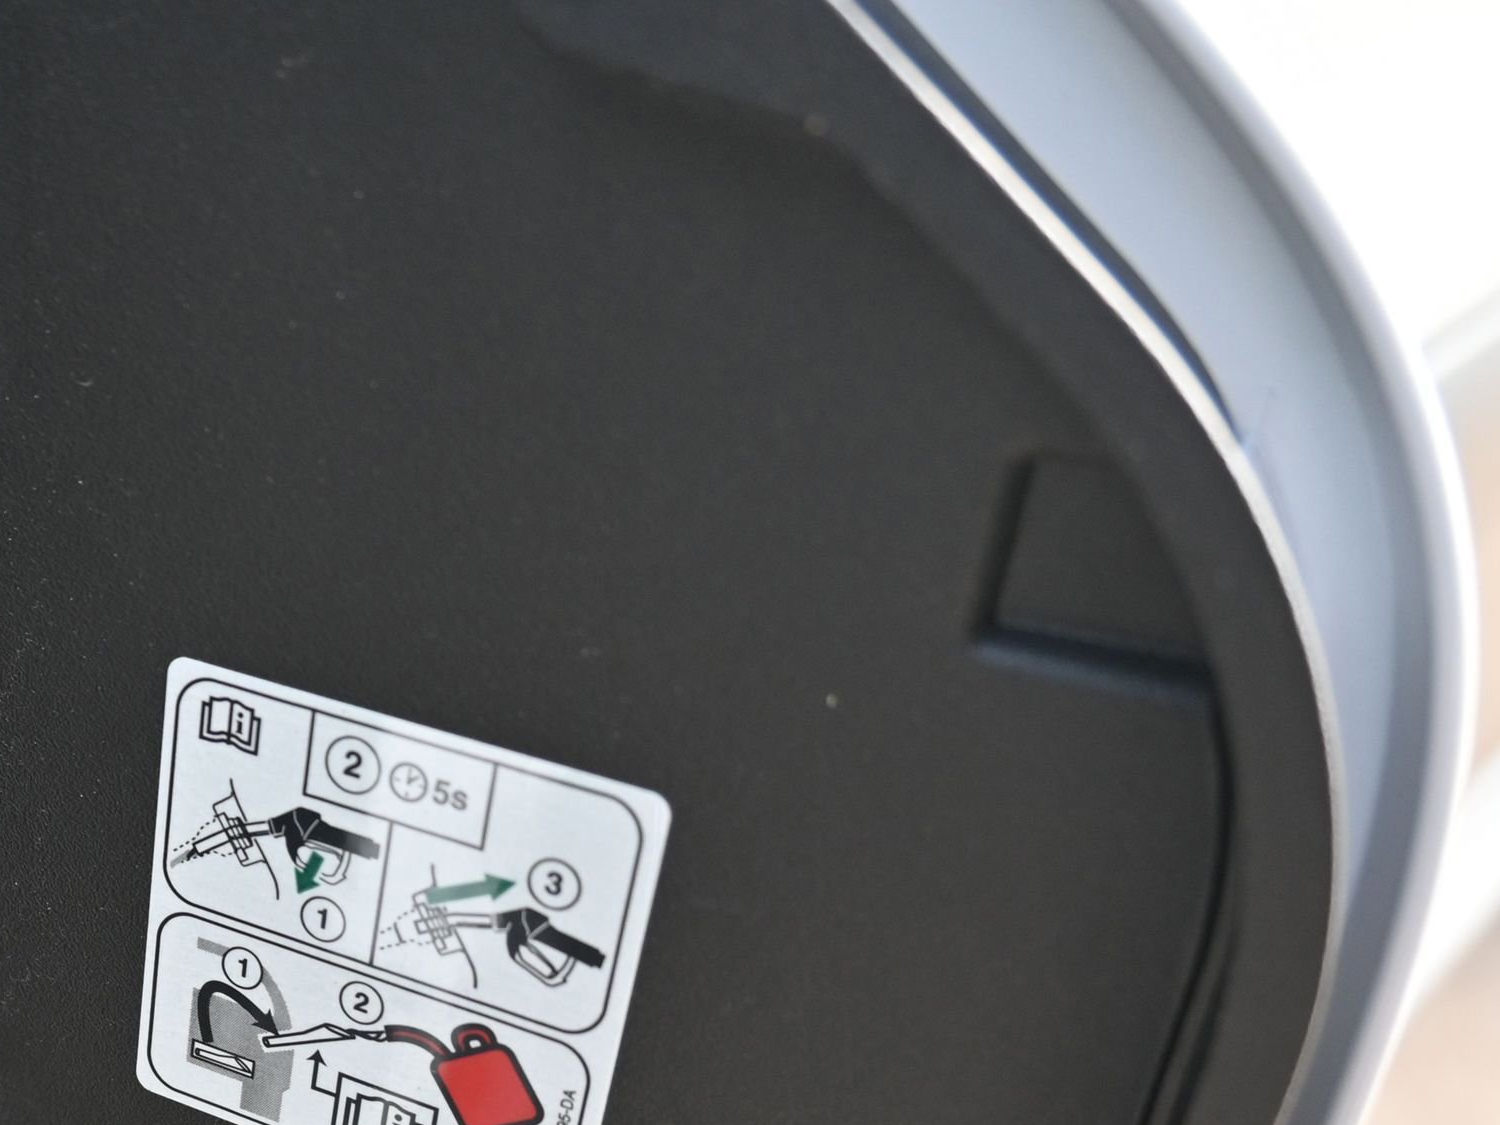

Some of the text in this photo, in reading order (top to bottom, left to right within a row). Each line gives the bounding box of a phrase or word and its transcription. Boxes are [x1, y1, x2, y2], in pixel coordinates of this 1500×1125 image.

[343, 750, 364, 779] 2
[432, 779, 469, 811] 5s
[544, 871, 565, 896] 3
[316, 908, 330, 930] 1
[238, 957, 249, 978] 1
[352, 992, 371, 1013] 2
